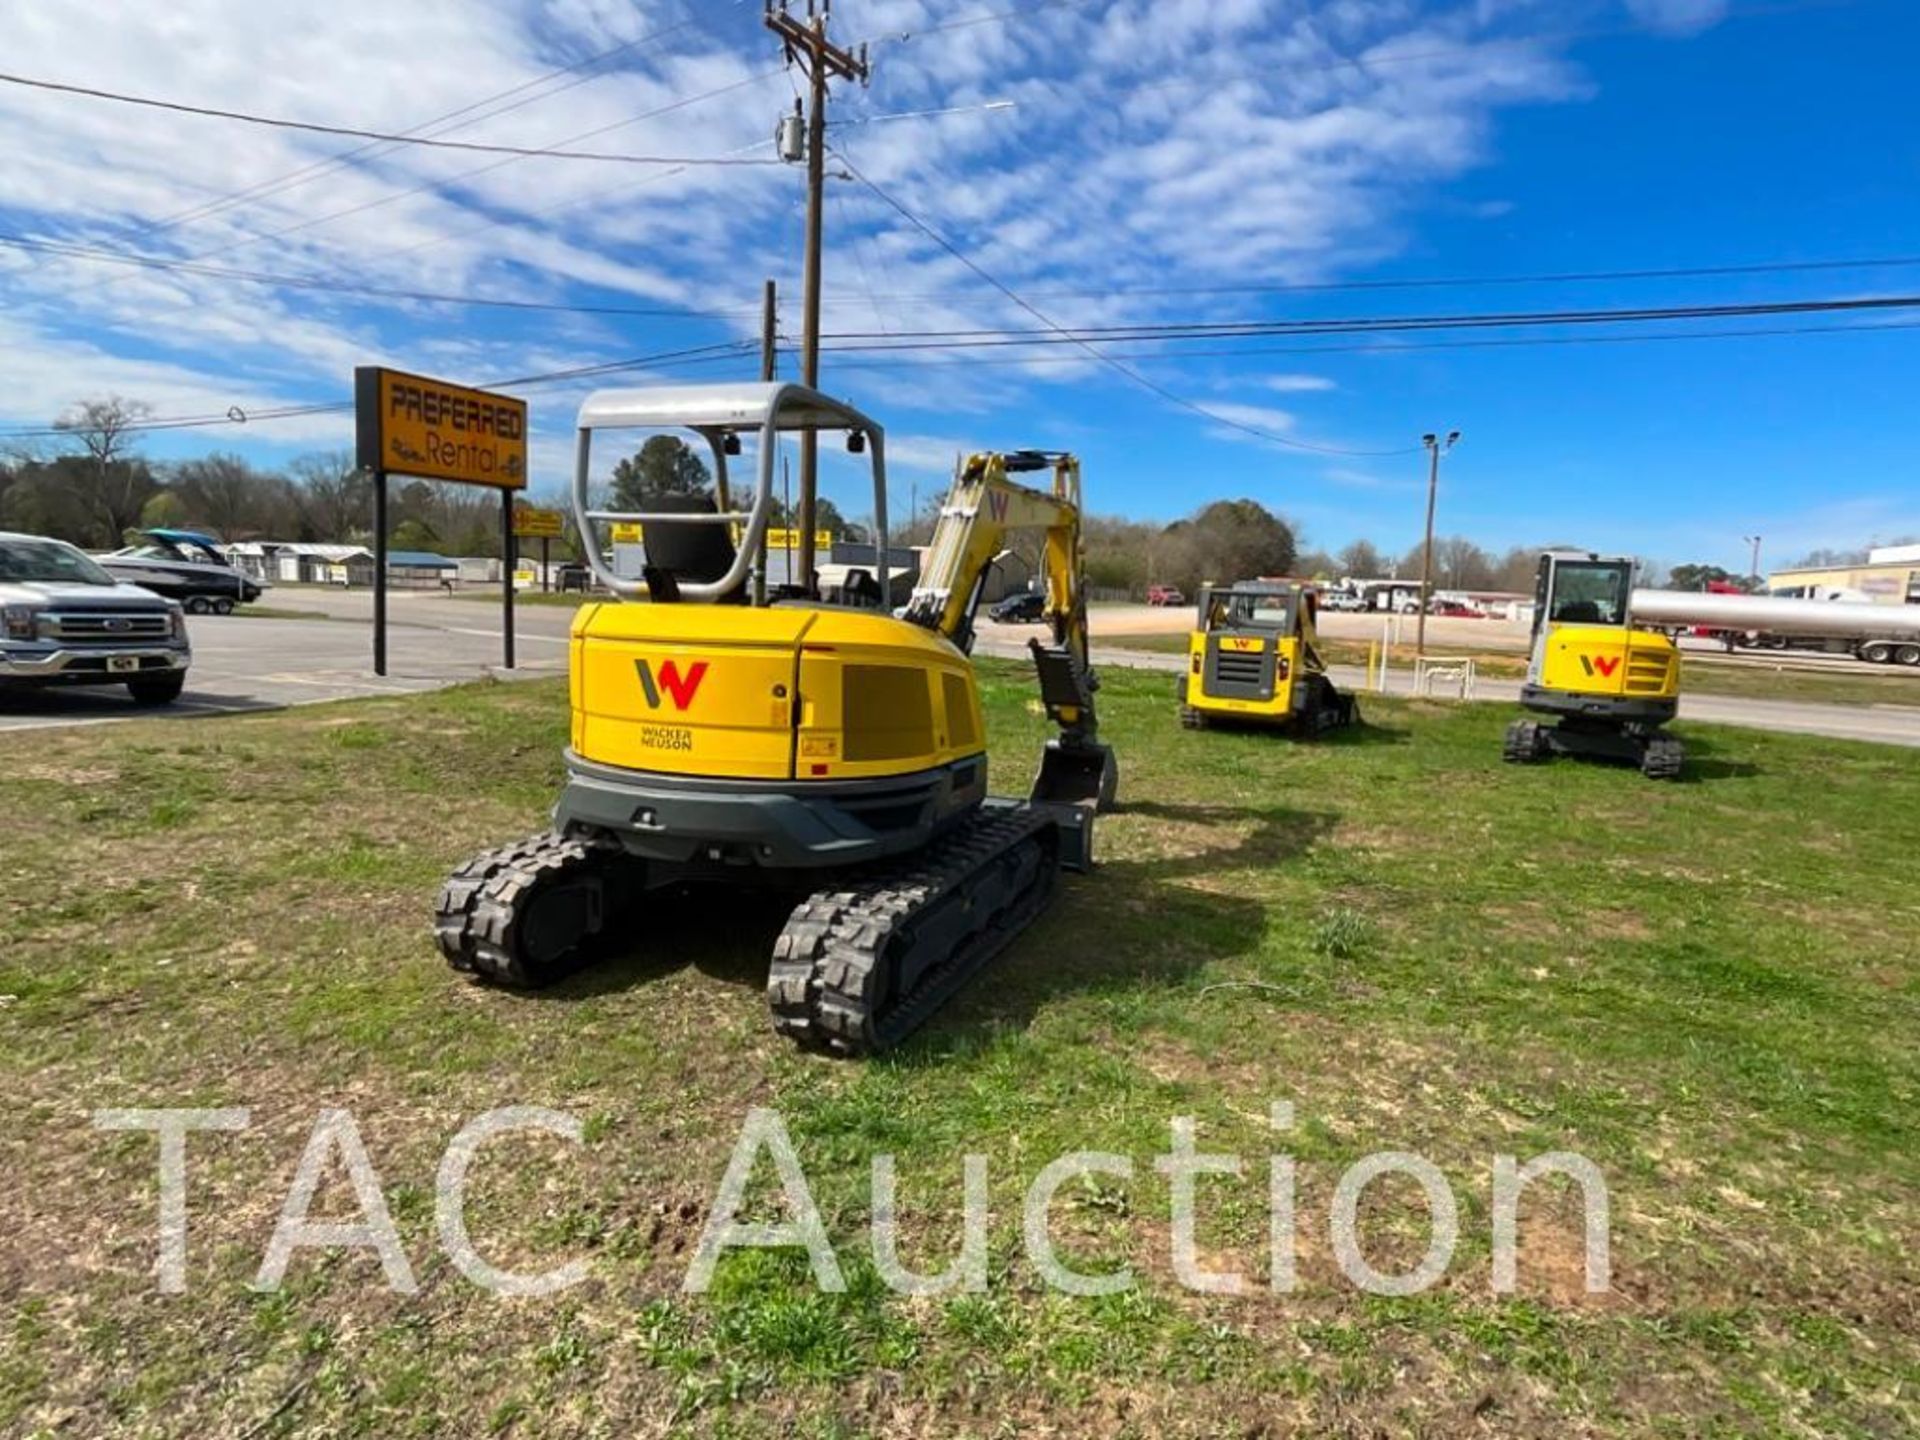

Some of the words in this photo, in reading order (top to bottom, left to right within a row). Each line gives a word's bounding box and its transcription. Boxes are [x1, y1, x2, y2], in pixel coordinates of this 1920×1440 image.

[391, 384, 521, 440] PREFERRED
[426, 431, 498, 473] Rental
[634, 658, 709, 711] W
